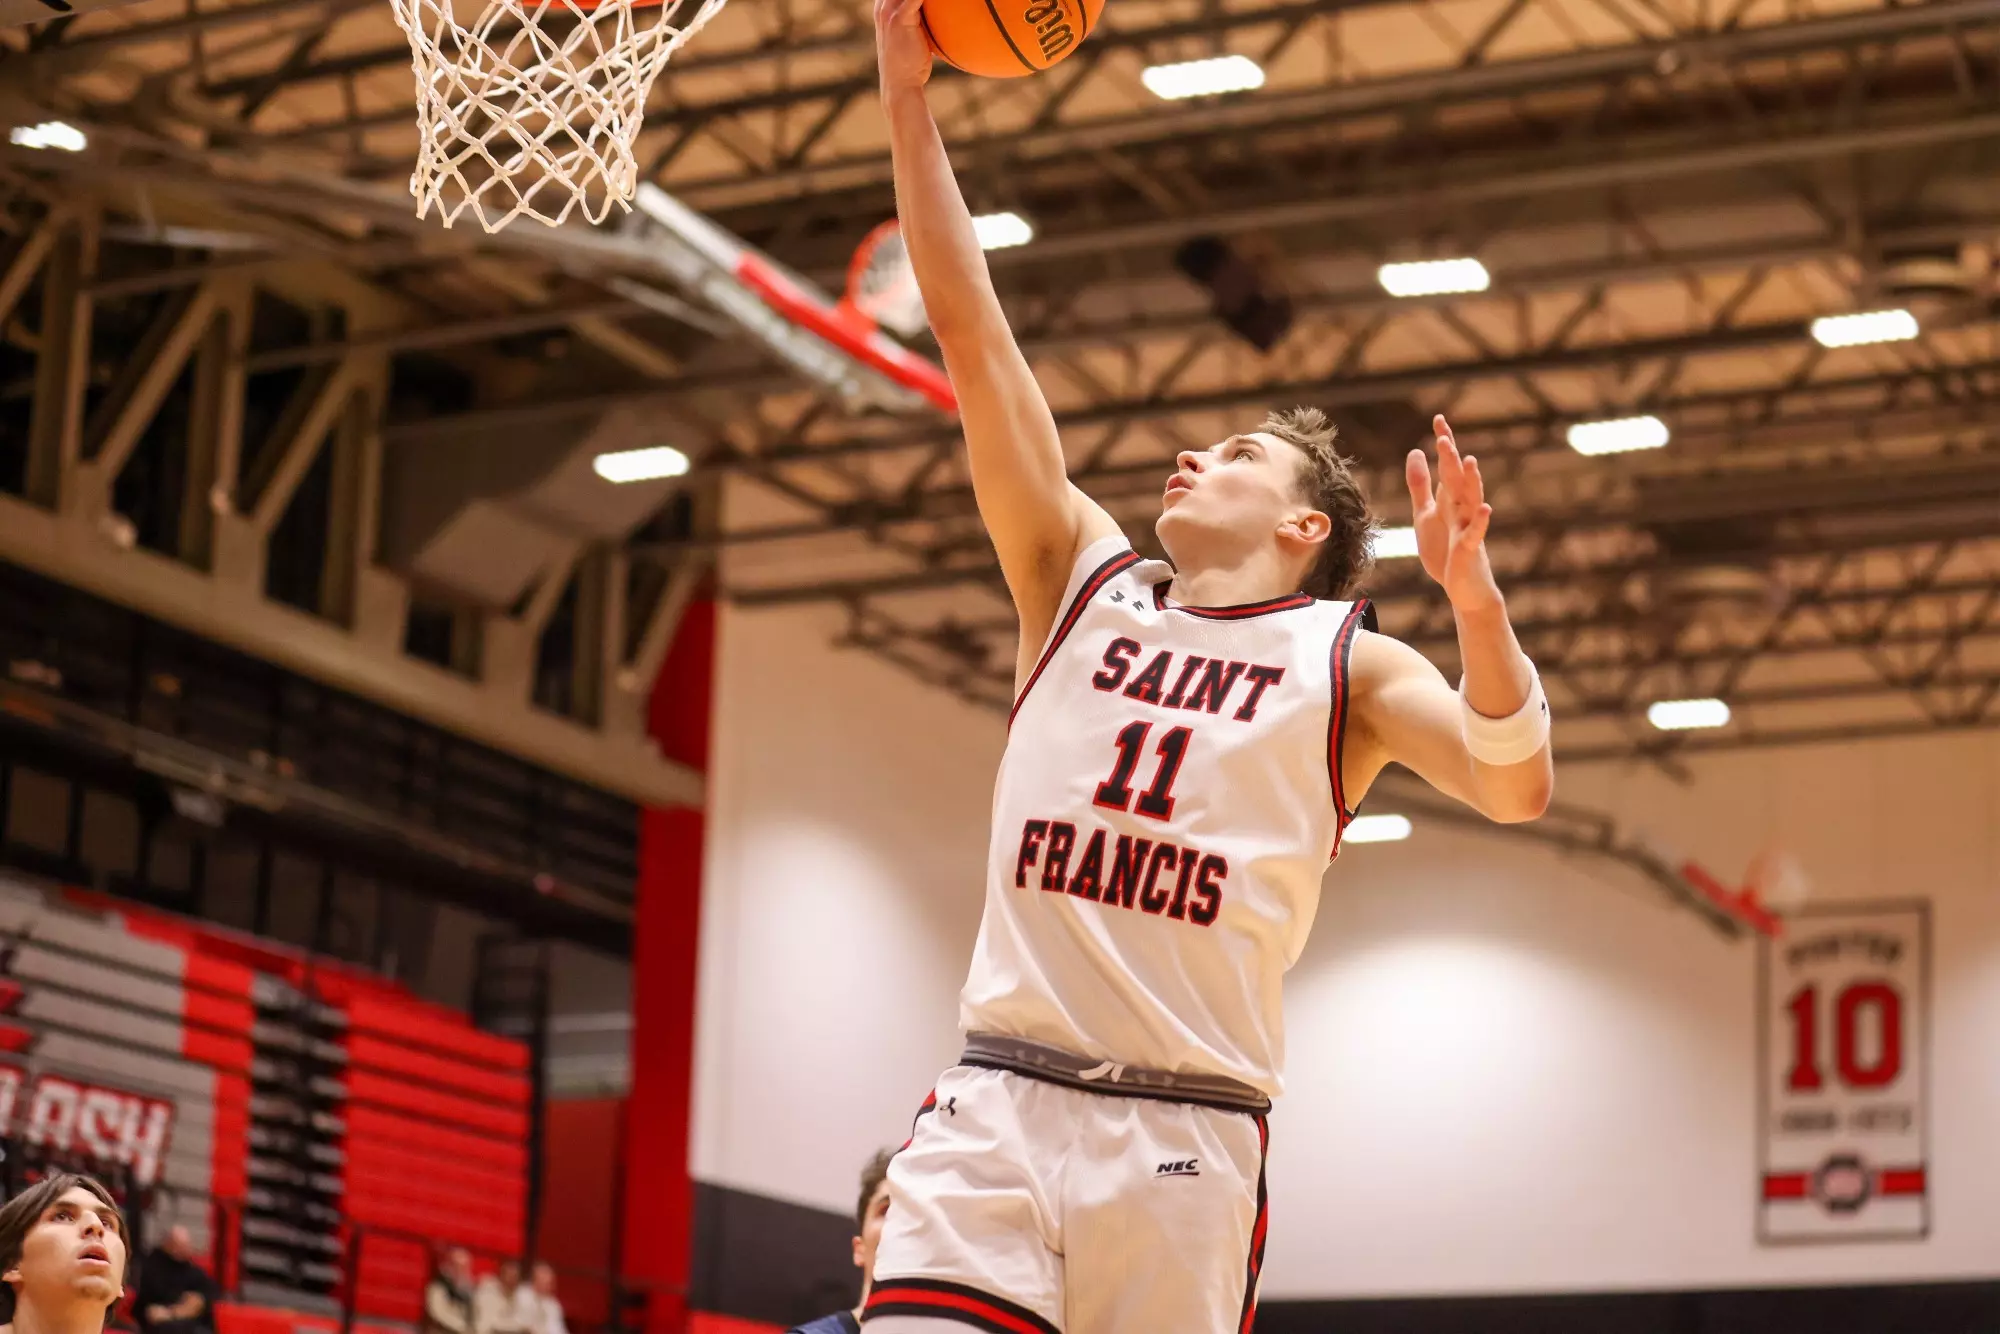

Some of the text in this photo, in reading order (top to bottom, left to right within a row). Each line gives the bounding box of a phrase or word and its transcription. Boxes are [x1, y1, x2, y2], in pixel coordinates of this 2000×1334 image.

[1092, 637, 1285, 722] SAINT
[1092, 719, 1193, 822] 11
[1015, 819, 1229, 927] FRANCIS
[1785, 978, 1904, 1093] 10
[1156, 1158, 1198, 1173] NEC
